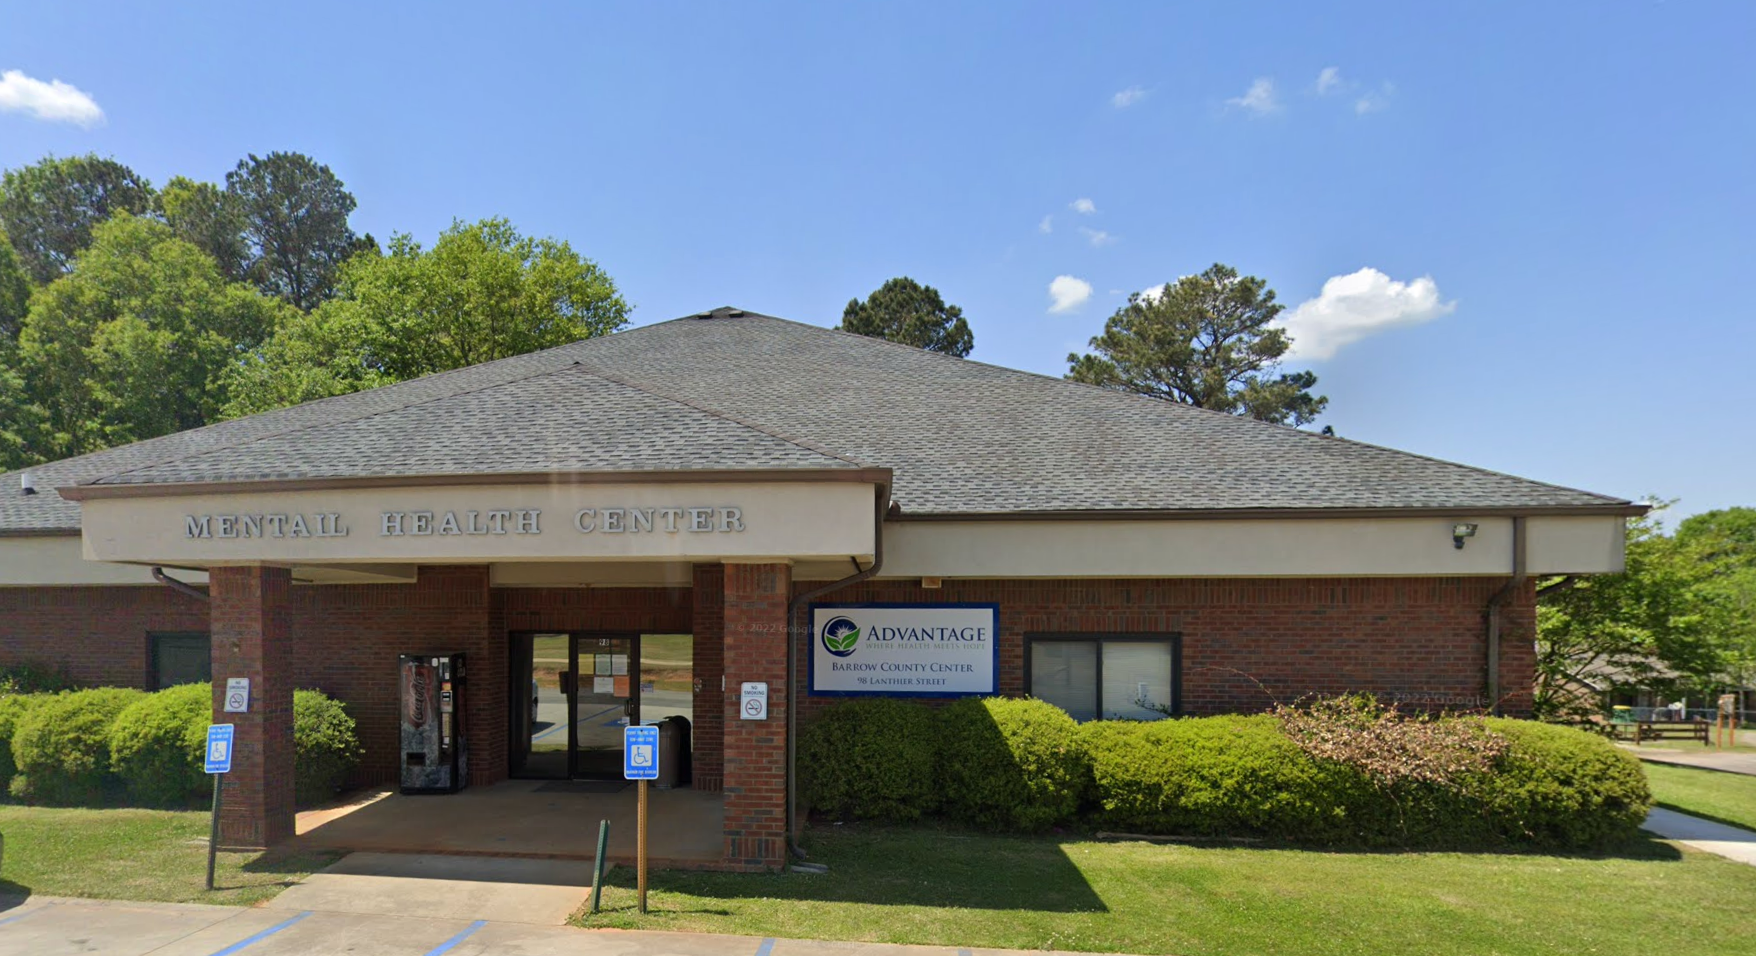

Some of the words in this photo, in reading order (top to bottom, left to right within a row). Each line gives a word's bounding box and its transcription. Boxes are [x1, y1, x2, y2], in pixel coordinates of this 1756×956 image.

[379, 509, 542, 537] HEALTH
[573, 507, 745, 534] CENTER
[866, 625, 986, 642] ADVANTAGE
[832, 662, 877, 672] BARROW
[881, 662, 927, 673] COUNTY
[928, 662, 974, 673] CENTER
[857, 677, 868, 685] 98
[870, 677, 913, 685] LANTHIER
[916, 677, 947, 686] STREET
